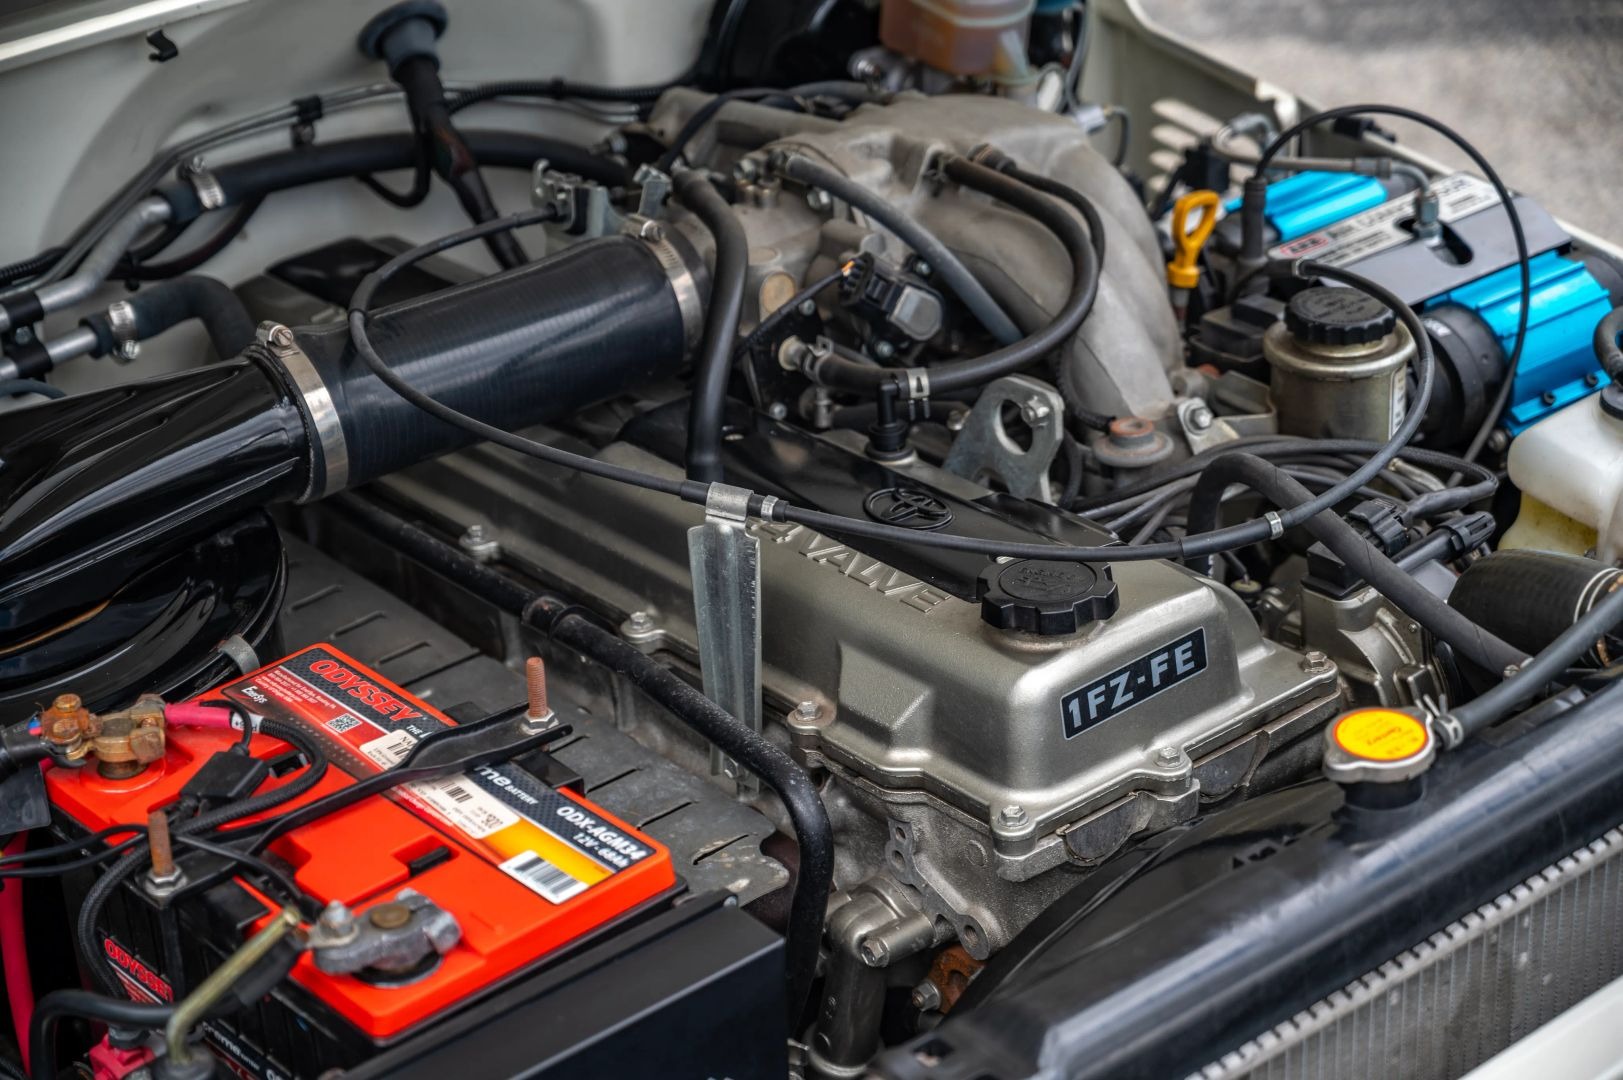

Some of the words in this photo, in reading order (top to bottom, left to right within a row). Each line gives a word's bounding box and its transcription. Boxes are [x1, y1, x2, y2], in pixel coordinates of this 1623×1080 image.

[799, 533, 952, 614] VALVE
[241, 685, 268, 705] EnerSys
[310, 659, 422, 722] ODYSSEY
[1068, 640, 1195, 728] 1FZ-FE
[406, 724, 422, 736] THE
[505, 784, 539, 806] BATTERY
[556, 806, 647, 861] ODX-AGM34
[572, 832, 596, 849] 12V
